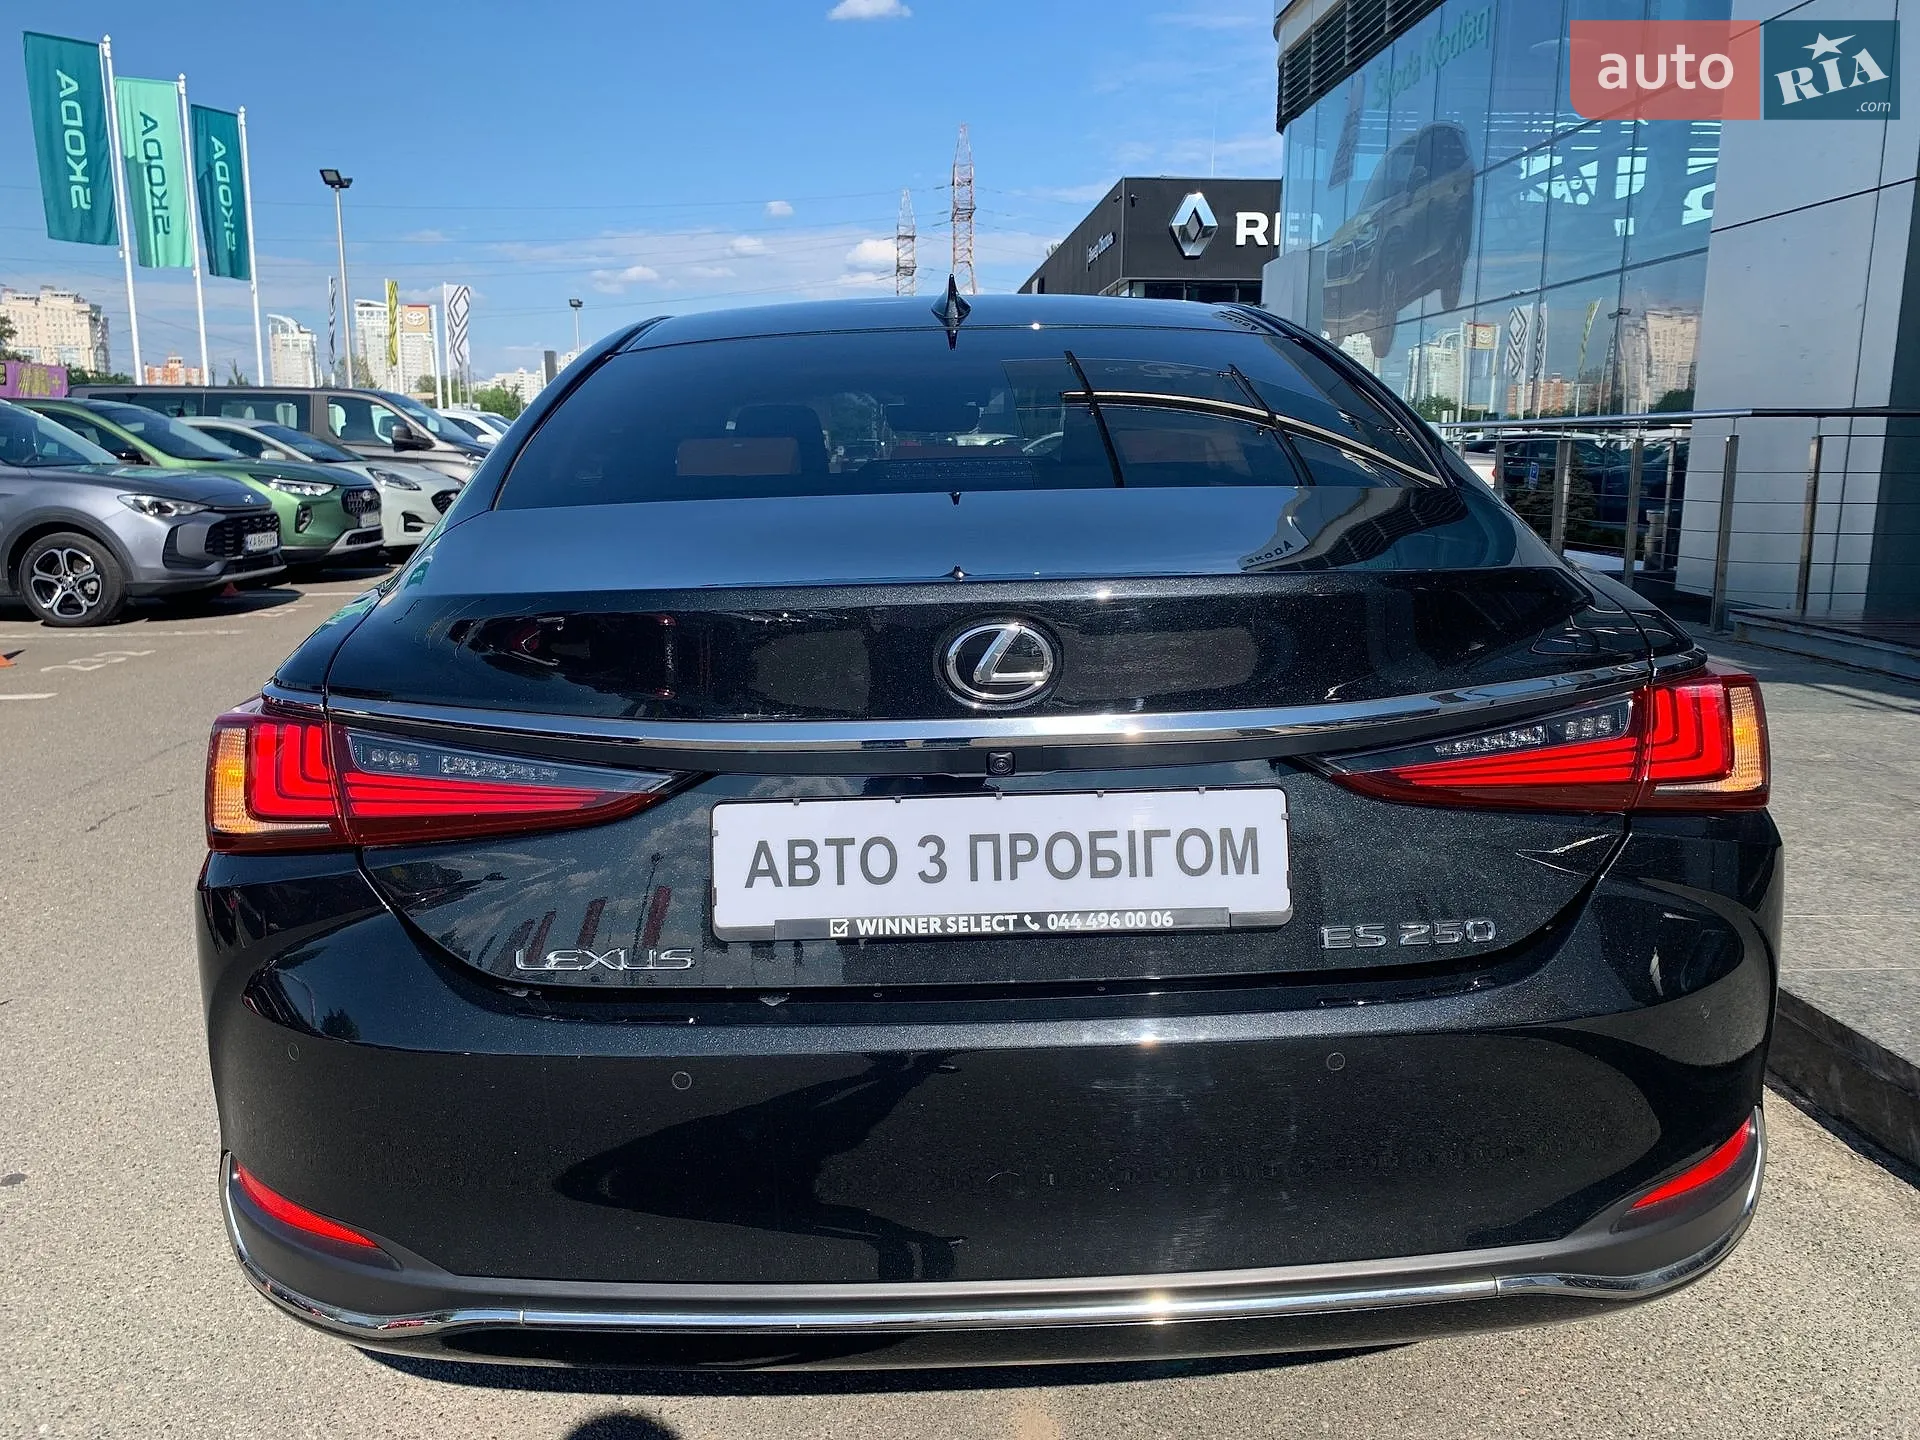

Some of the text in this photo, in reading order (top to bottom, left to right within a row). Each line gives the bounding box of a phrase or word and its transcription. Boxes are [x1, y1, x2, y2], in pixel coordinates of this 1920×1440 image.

[745, 837, 899, 889] АВТО
[968, 827, 1260, 882] ПРОБІГОМ
[855, 911, 1174, 935] WINNER SELECT 044 496 00 06
[1319, 918, 1497, 949] ES 250
[515, 948, 696, 971] LEXUS
